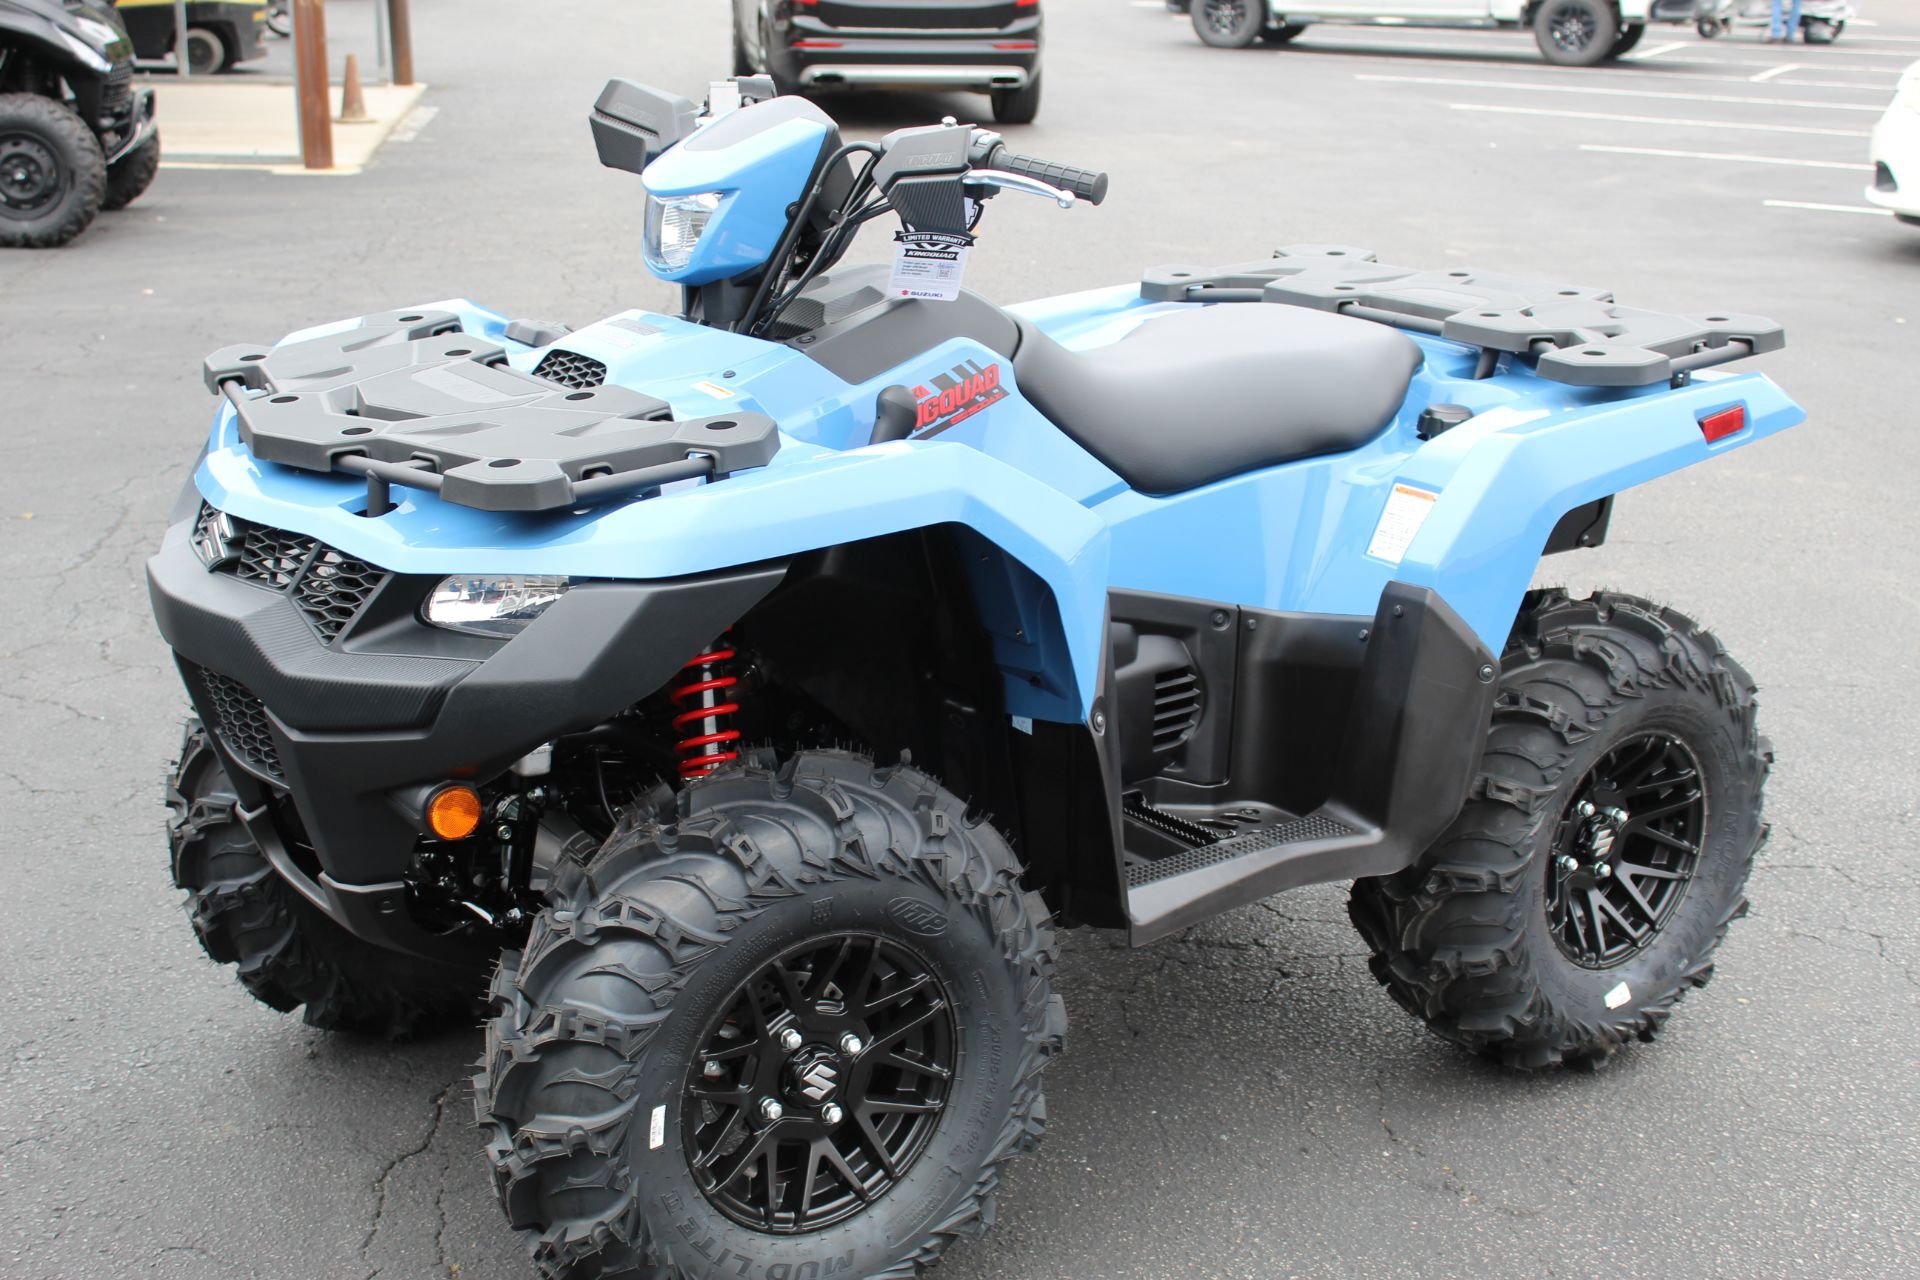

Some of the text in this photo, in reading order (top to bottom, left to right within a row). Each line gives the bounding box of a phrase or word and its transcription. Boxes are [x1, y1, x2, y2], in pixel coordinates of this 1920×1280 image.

[902, 233, 967, 246] LIMITED WARRANTY
[906, 250, 956, 259] KINGQUAD
[910, 290, 943, 298] SUZUKI
[890, 899, 949, 931] ITP
[676, 1215, 754, 1278] LITE
